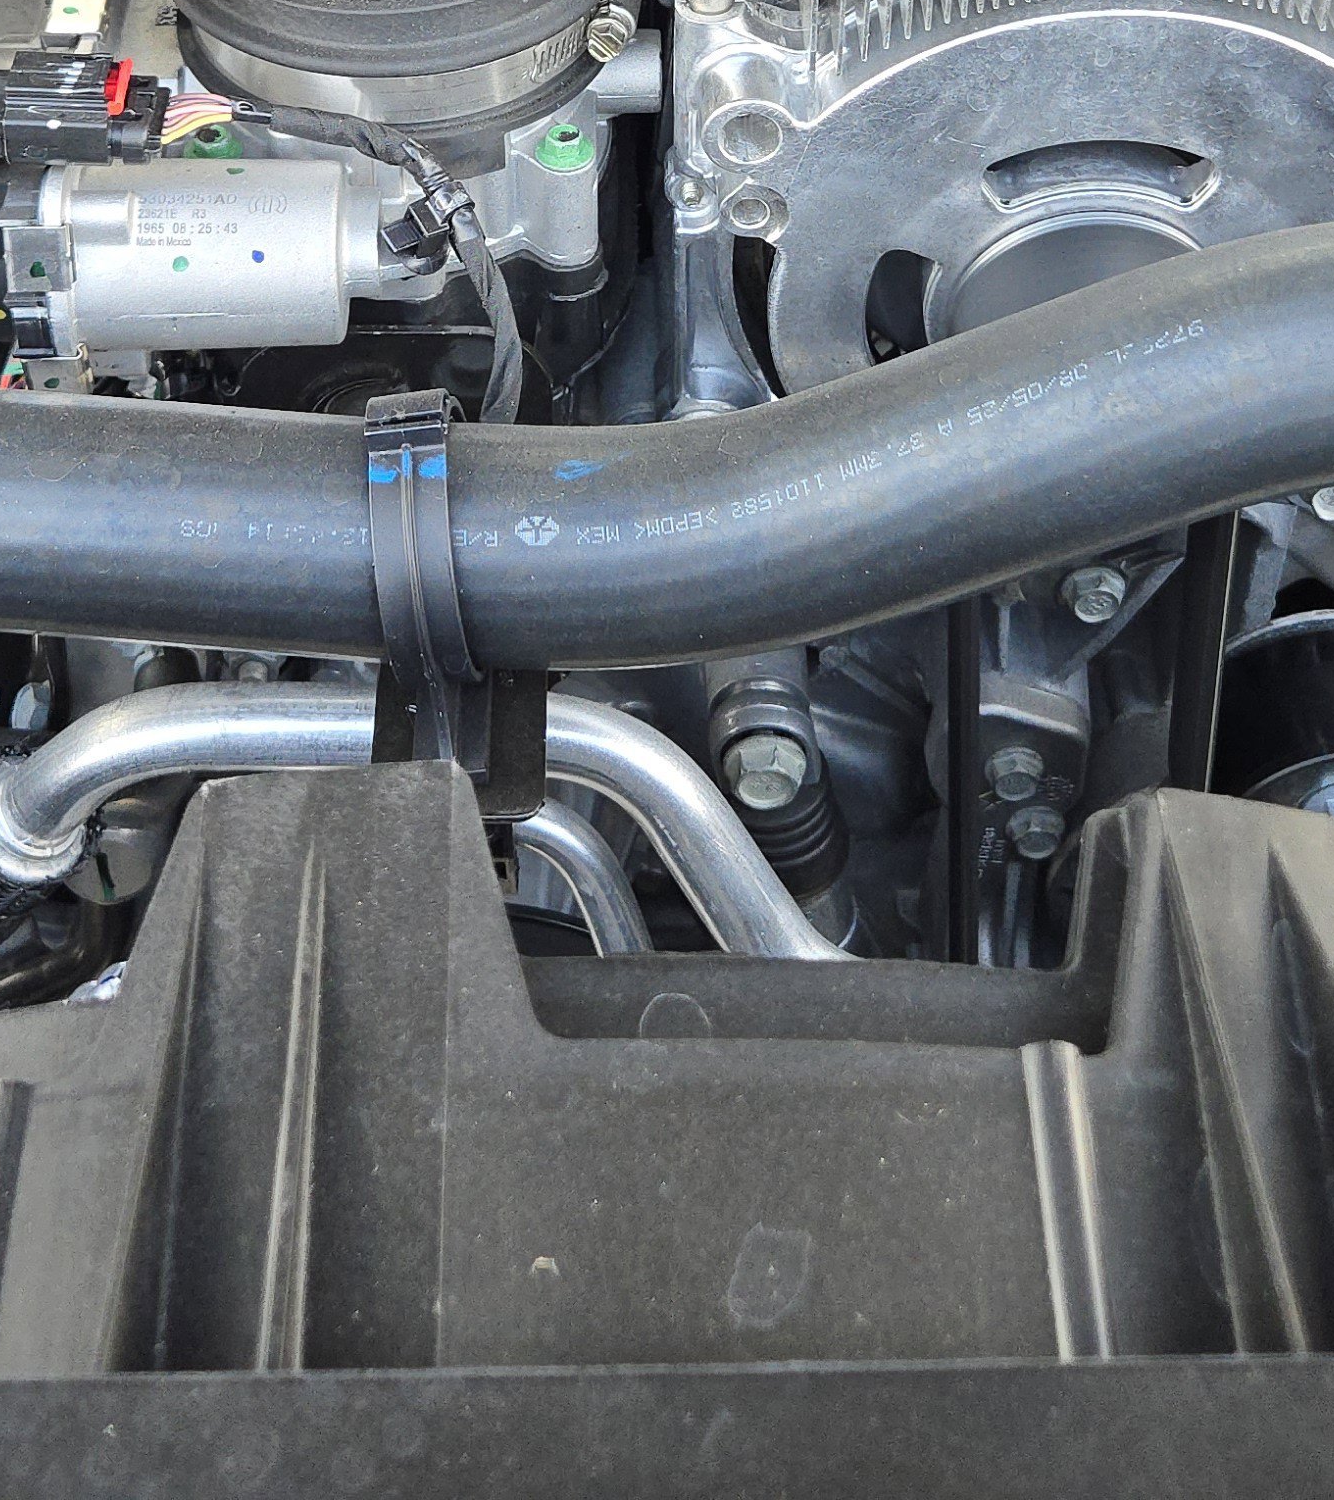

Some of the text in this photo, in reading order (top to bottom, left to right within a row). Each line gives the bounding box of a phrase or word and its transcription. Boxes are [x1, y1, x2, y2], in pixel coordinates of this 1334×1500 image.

[192, 208, 207, 219] R3
[137, 222, 165, 234] 1965
[136, 236, 157, 247] Made
[166, 236, 192, 247] Mexico
[937, 417, 954, 438] A
[838, 430, 925, 482] 37.3MM
[730, 471, 826, 520] 1101582
[451, 527, 499, 548] R/E
[575, 523, 622, 547] MEX
